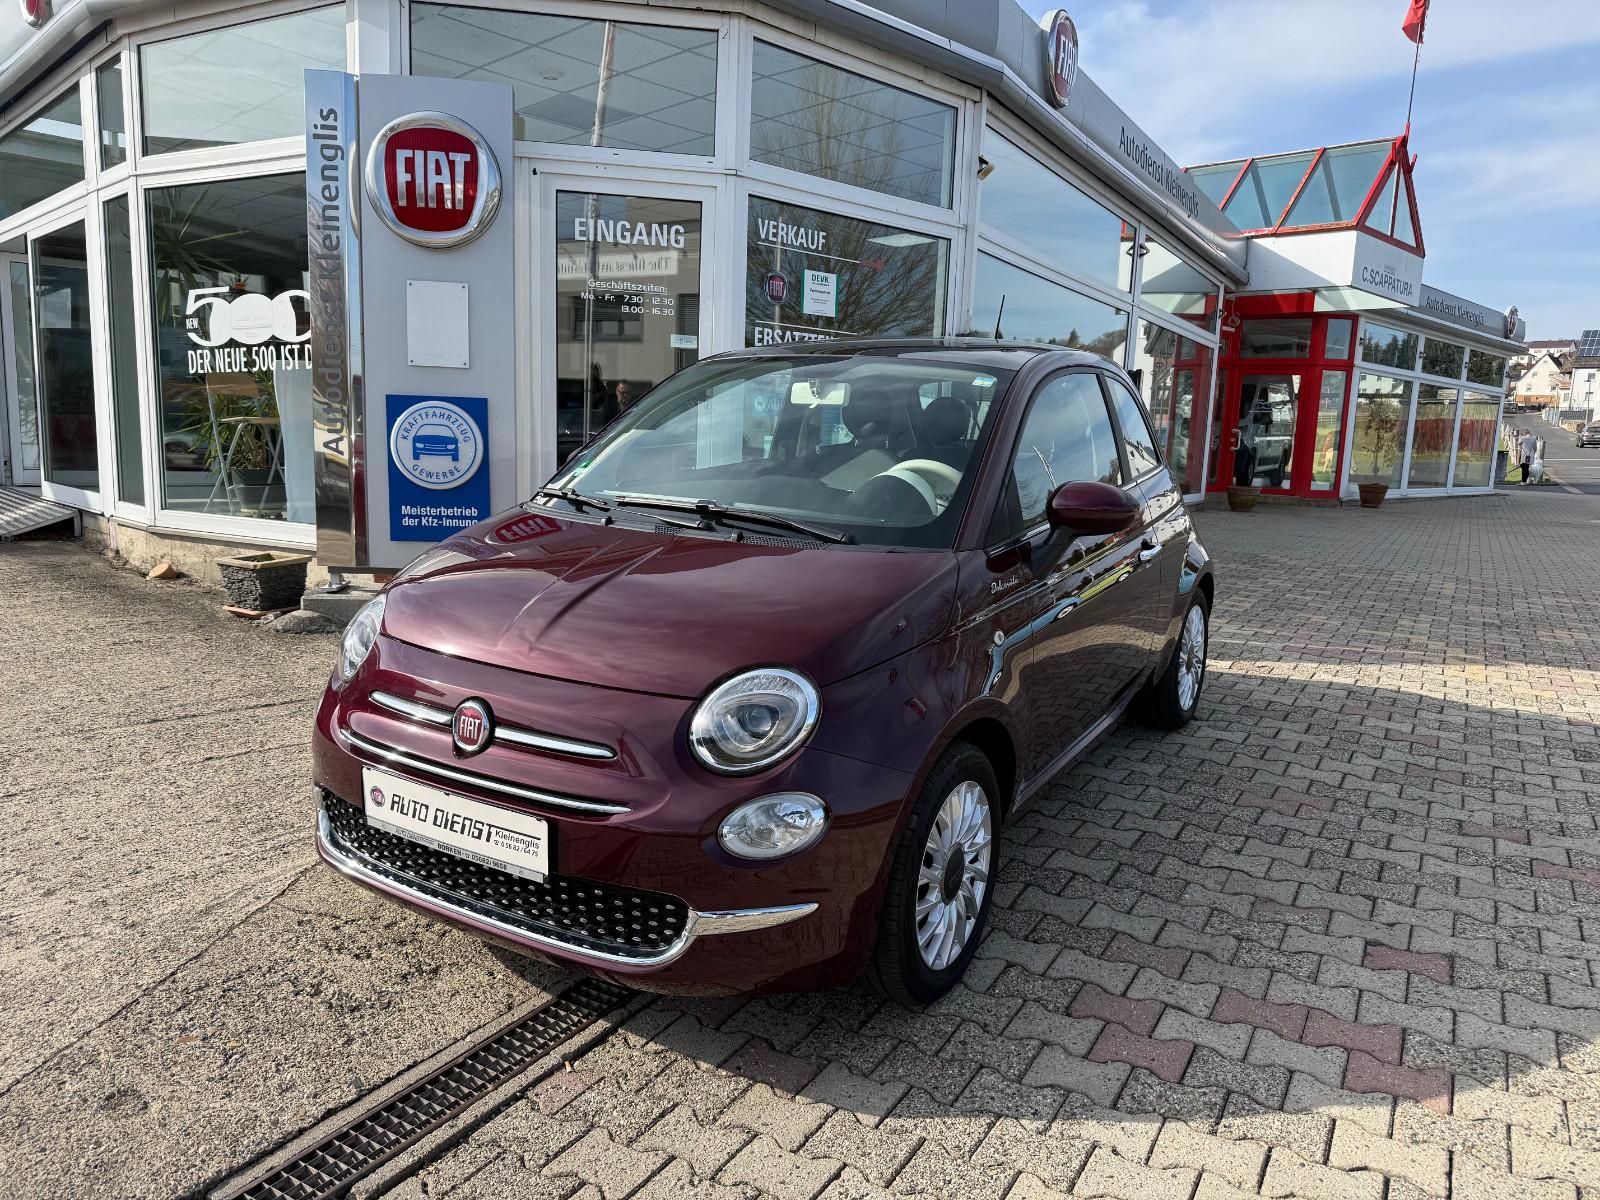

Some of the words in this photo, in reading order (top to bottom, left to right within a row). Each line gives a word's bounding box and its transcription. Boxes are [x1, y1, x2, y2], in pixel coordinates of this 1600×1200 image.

[395, 149, 471, 210] FIAT
[1119, 125, 1164, 185] Autodienst
[1165, 167, 1199, 218] Kleinenglis
[312, 107, 345, 280] Kleinenglis
[574, 217, 685, 249] EINGANG
[758, 218, 827, 251] VERKAUF
[588, 279, 668, 293] Geschäftszeiten:
[769, 280, 784, 297] FIAT
[811, 273, 830, 284] DEVK
[580, 291, 596, 301] Mo.
[604, 293, 616, 302] Fr.
[624, 294, 643, 304] 7.30
[652, 297, 674, 306] 12.30
[186, 285, 312, 347] 500
[621, 305, 644, 314] 13.00
[652, 307, 674, 316] 16.30
[186, 317, 199, 329] NEW
[188, 349, 212, 374] DER
[215, 347, 249, 373] NEUE
[252, 345, 276, 372] 500
[280, 344, 300, 371] IST
[304, 344, 312, 369] D
[313, 284, 344, 456] Autodienst
[401, 410, 471, 443] KRAFTFAHRZEUG
[412, 464, 461, 480] GEWERBE
[401, 505, 478, 517] Meisterbetrieb
[402, 517, 419, 526] der
[459, 715, 481, 740] FIAT
[390, 793, 429, 823] AUTO
[433, 807, 493, 843] DIENST
[437, 843, 462, 857] BORKEN
[495, 829, 540, 850] Kleinenglis
